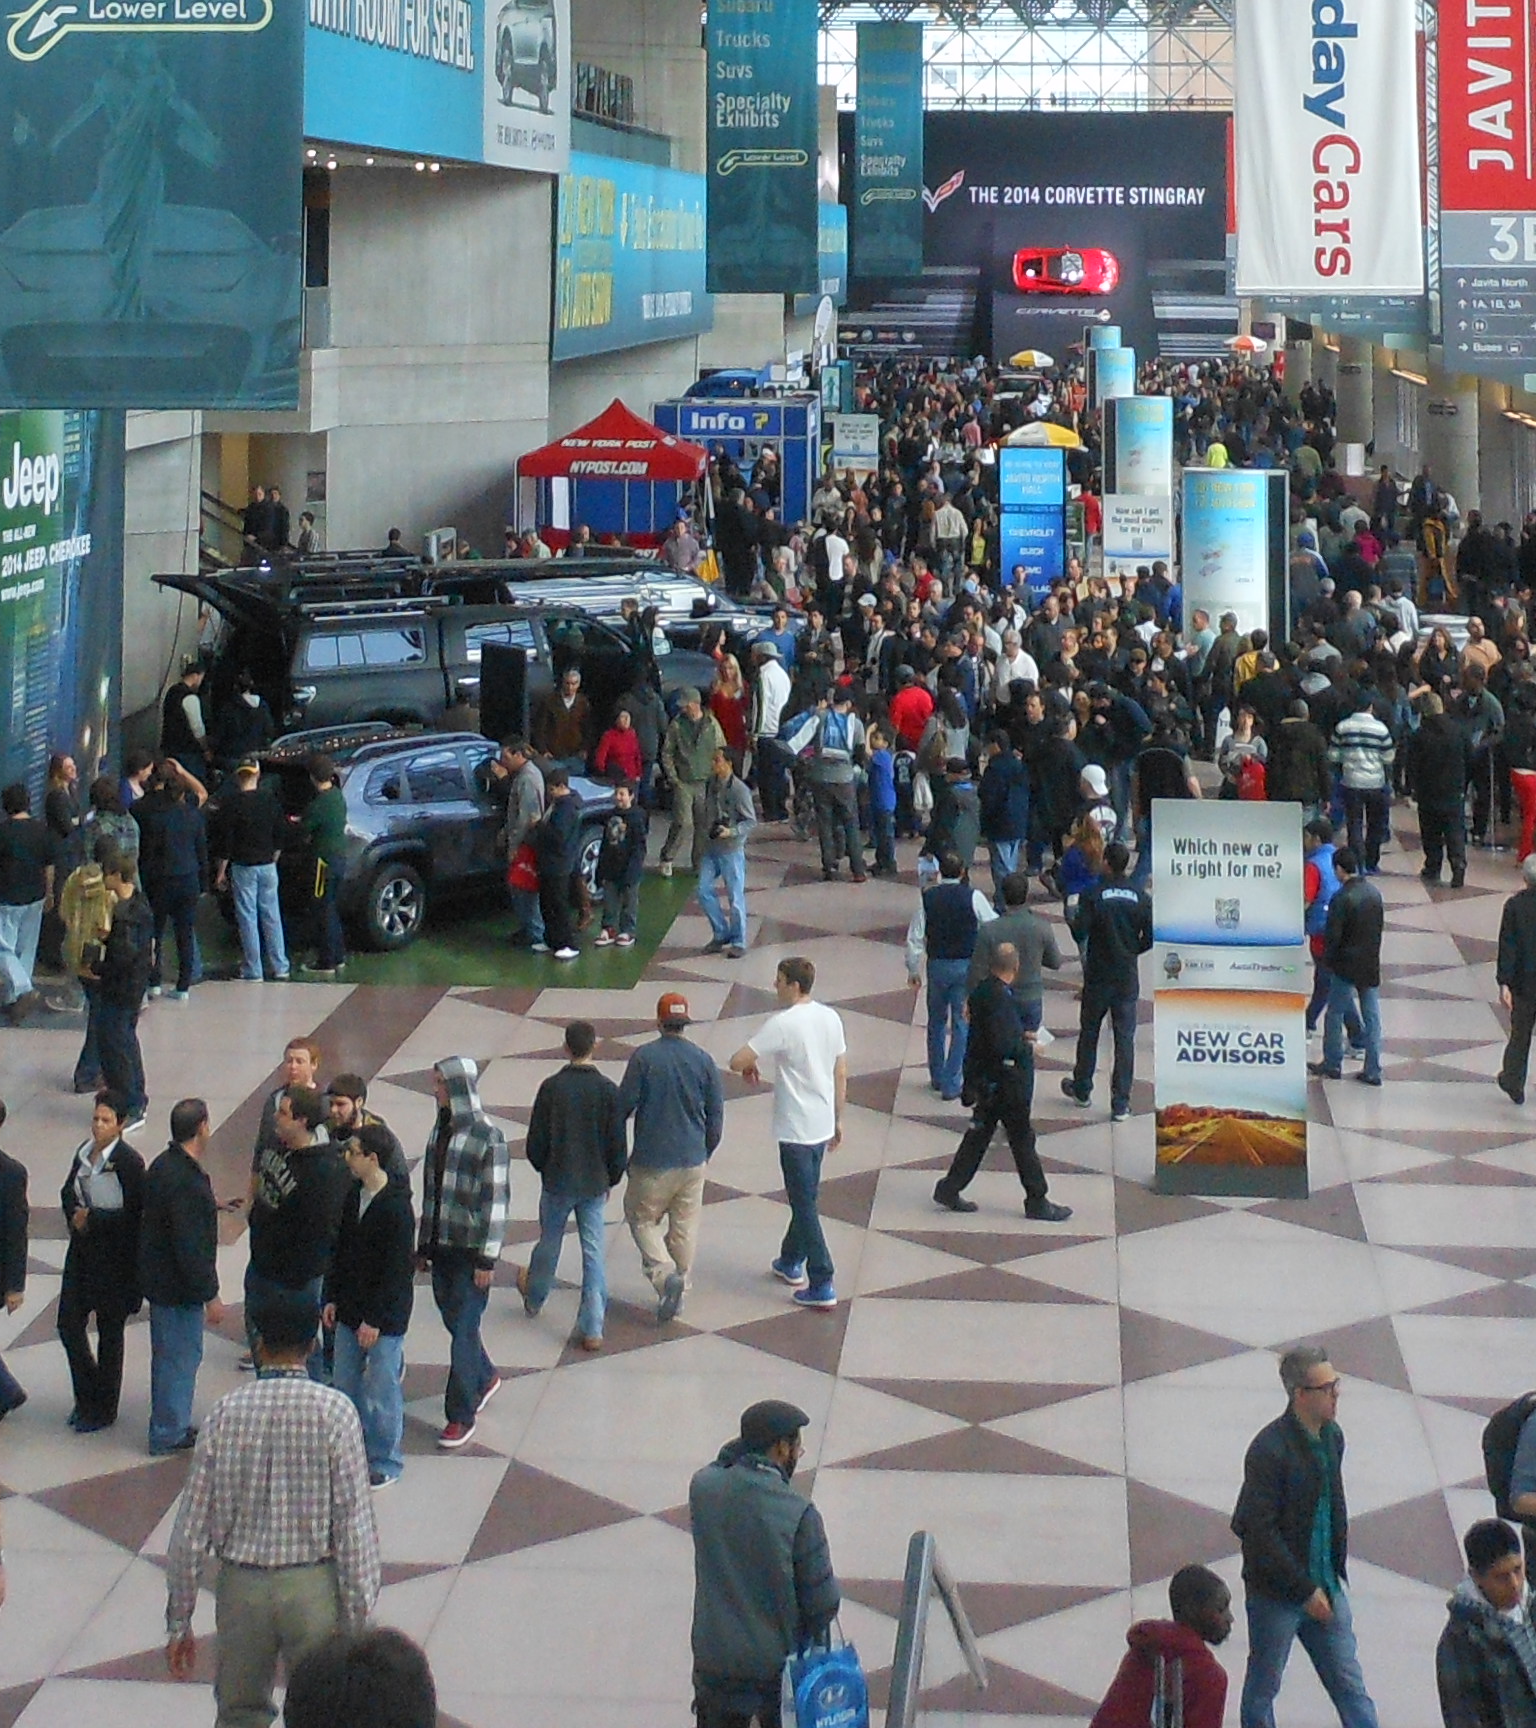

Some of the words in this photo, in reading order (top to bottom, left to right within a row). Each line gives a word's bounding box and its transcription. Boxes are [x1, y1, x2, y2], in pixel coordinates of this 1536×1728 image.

[717, 30, 770, 48] Trucks
[717, 61, 753, 79] Suvs
[717, 92, 791, 113] Specialty
[717, 110, 780, 128] Exhibits
[969, 186, 999, 204] THE
[1003, 186, 1040, 204] 2014
[1044, 186, 1125, 205] CORVETTE
[1129, 186, 1206, 206] STINGRAY
[691, 412, 745, 430] Info
[561, 438, 585, 448] NEW
[587, 438, 622, 448] YORK
[626, 438, 657, 448] POST
[569, 461, 648, 475] NYPOST.COM
[2, 441, 59, 515] Jeep
[2, 554, 22, 578] 2014
[49, 533, 91, 566] CHEROKEE
[1173, 837, 1217, 856] Which
[1223, 840, 1252, 857] new
[1258, 841, 1279, 858] car
[1171, 859, 1182, 876] is
[1186, 859, 1222, 879] right
[1227, 860, 1248, 877] for
[1253, 861, 1282, 879] me?
[1177, 1031, 1230, 1047] NEW
[1238, 1032, 1284, 1049] CAR
[1177, 1048, 1285, 1064] ADVISORS
